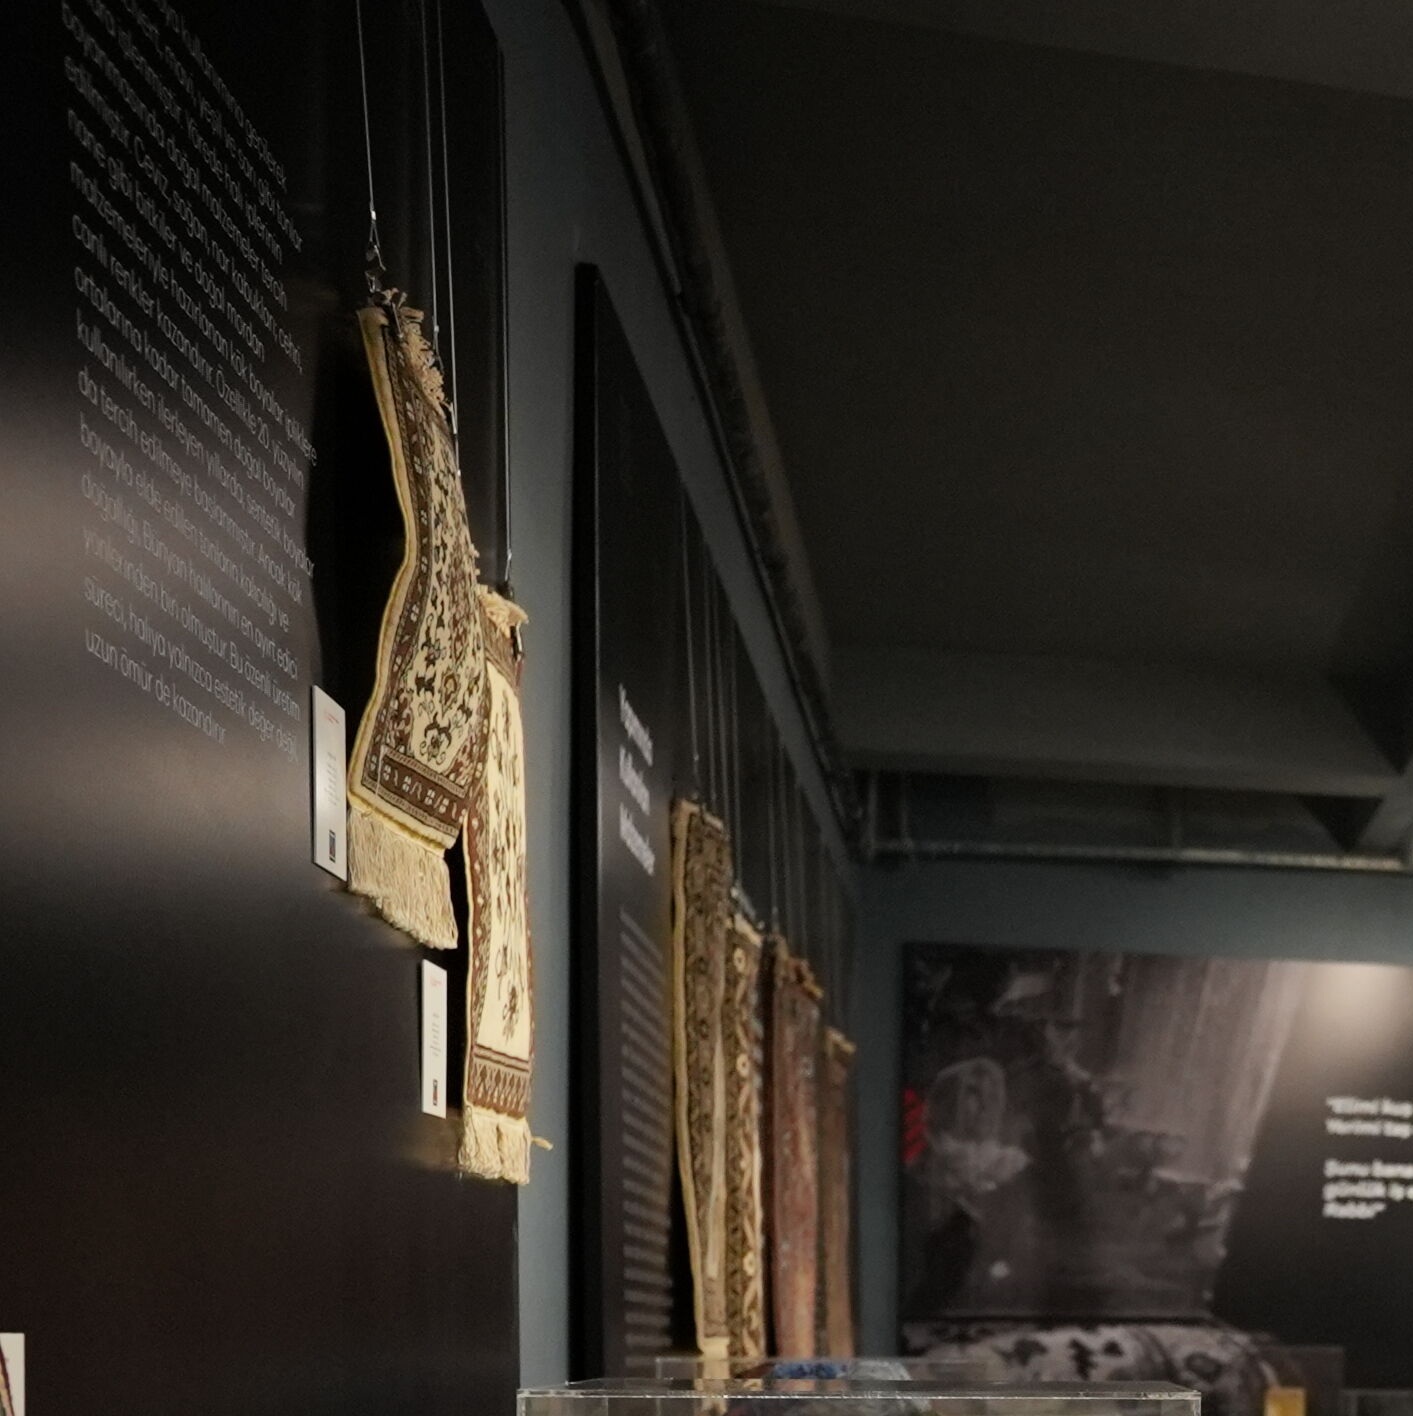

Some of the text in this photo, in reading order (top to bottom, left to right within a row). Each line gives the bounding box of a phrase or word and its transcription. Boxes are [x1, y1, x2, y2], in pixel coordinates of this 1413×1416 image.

[134, 132, 171, 210] Ceviz,
[212, 241, 229, 277] nar
[166, 129, 200, 196] doğal
[262, 258, 287, 310] tercih
[224, 130, 236, 159] ve
[68, 107, 106, 168] nane
[107, 156, 133, 201] gibi
[179, 243, 193, 274] ve
[194, 253, 225, 312] doğal
[227, 302, 265, 361] mordan
[72, 213, 108, 268] canlı
[110, 256, 155, 321] renkler
[216, 365, 256, 435] Özellikle
[74, 265, 296, 518] ortalarına kadar tamamen doğal boyalar
[231, 343, 249, 385] kök
[250, 365, 284, 426] boyalar
[77, 360, 98, 405] da
[101, 386, 138, 443] tercih
[140, 431, 193, 496] edilmeye
[259, 542, 285, 585] Ancak
[288, 570, 303, 602] kök
[80, 413, 133, 486] boyayla
[135, 473, 162, 513] elde
[278, 609, 289, 631] ve
[158, 397, 205, 465] ilerleyen
[284, 527, 314, 577] boyalar
[85, 629, 119, 668] uzun
[120, 649, 153, 692] ömür
[155, 673, 170, 704] de
[129, 606, 166, 655] halıya
[168, 644, 212, 691] yalnızca
[214, 681, 247, 718] estetik
[248, 701, 275, 739] değer
[230, 643, 243, 672] Bu
[241, 616, 254, 639] en
[255, 629, 276, 658] ayırt
[277, 646, 298, 677] edici
